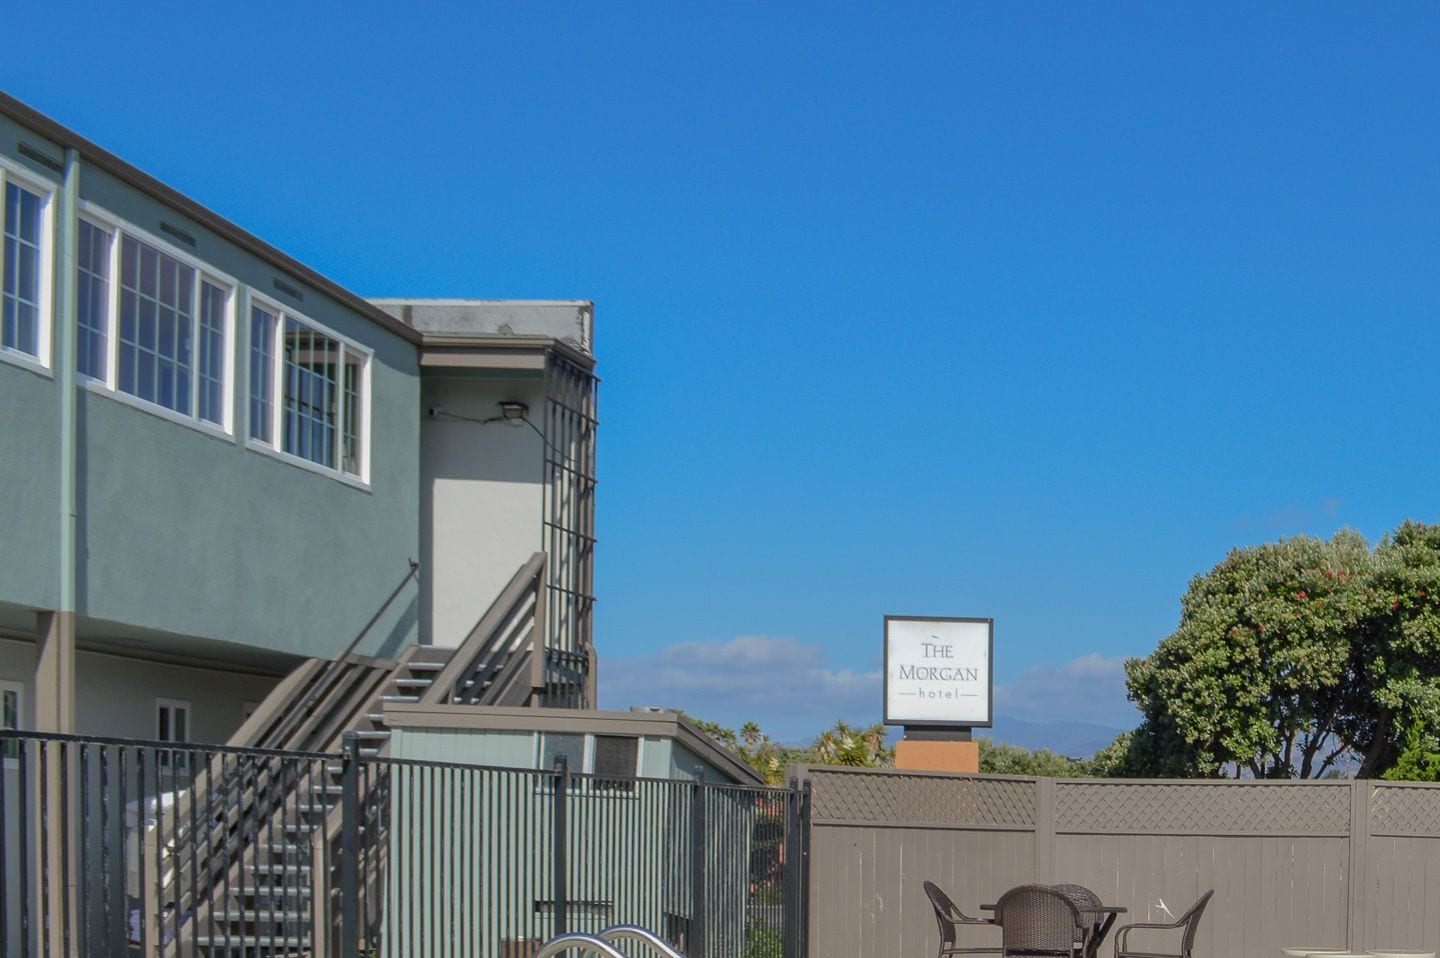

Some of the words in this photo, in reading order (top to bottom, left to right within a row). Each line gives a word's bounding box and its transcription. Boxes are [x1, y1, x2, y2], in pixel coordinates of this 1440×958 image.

[921, 643, 953, 659] THE
[899, 665, 978, 681] MORGAN
[919, 687, 958, 699] hotel
